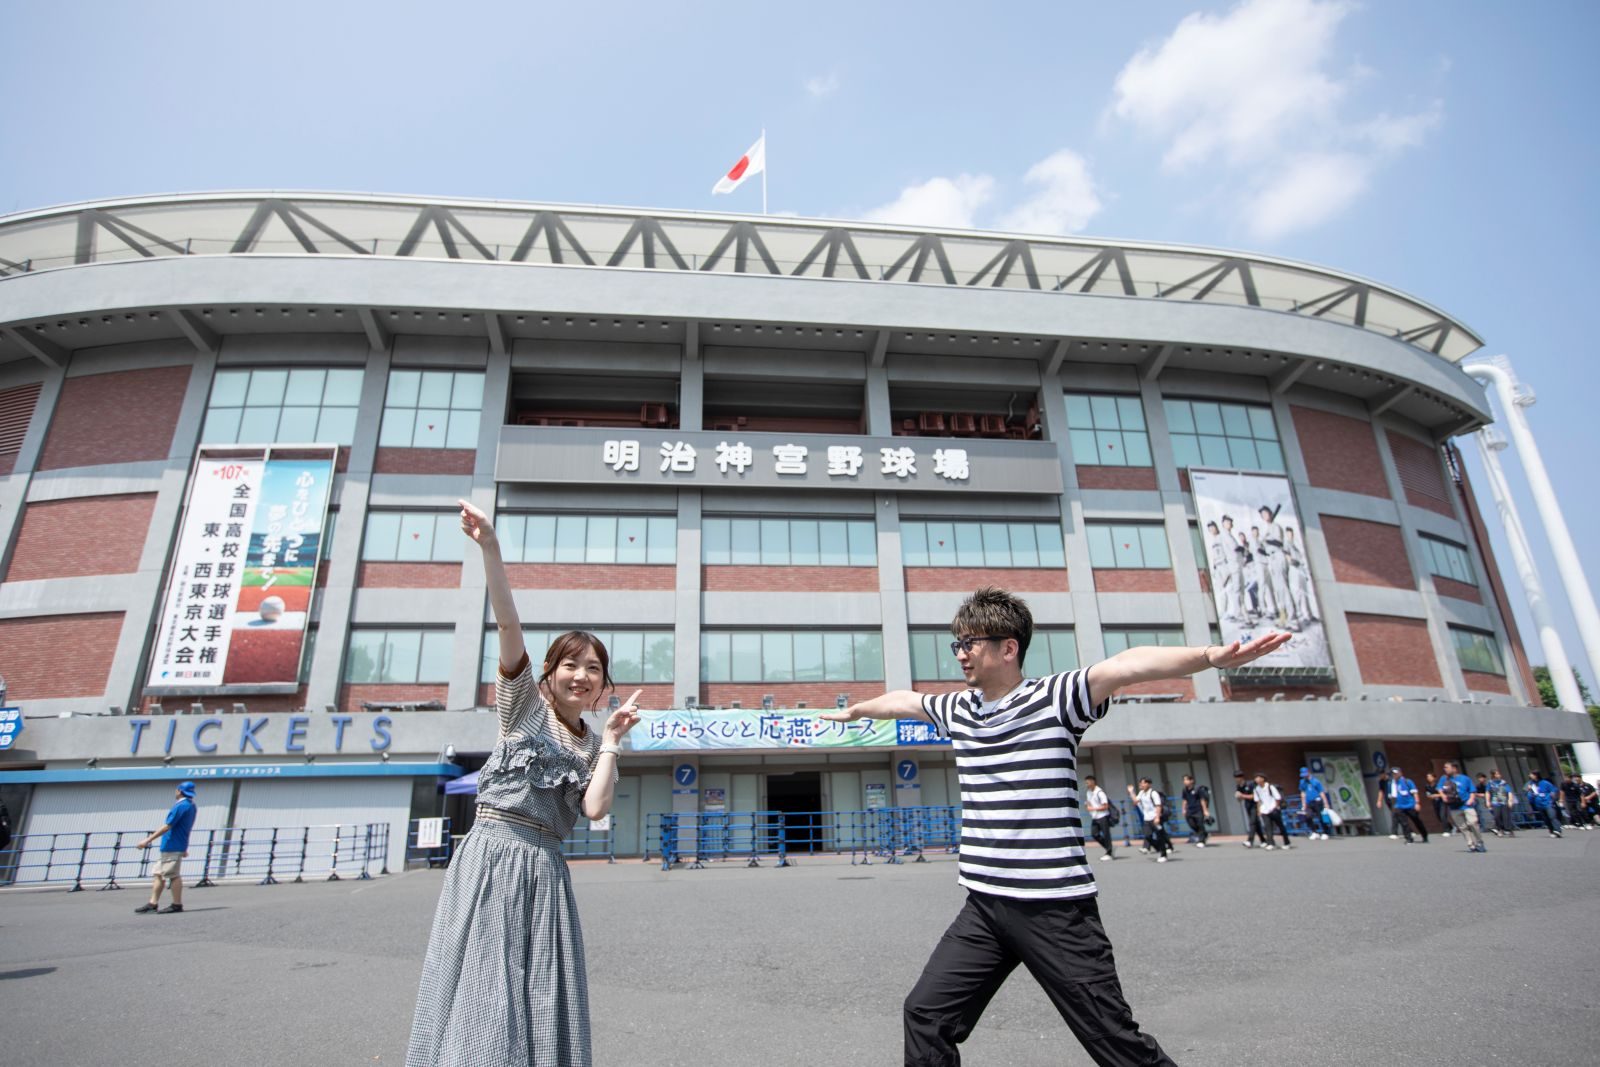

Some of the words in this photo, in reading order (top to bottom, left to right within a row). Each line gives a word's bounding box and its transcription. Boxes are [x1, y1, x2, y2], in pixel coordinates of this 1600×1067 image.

[603, 439, 969, 480] 明治神宮野球場
[175, 522, 221, 664] 東・西東京大会
[198, 483, 251, 664] 全国高校野球選手権
[130, 716, 393, 754] TICKETS
[681, 768, 692, 783] 7
[902, 764, 913, 778] 7
